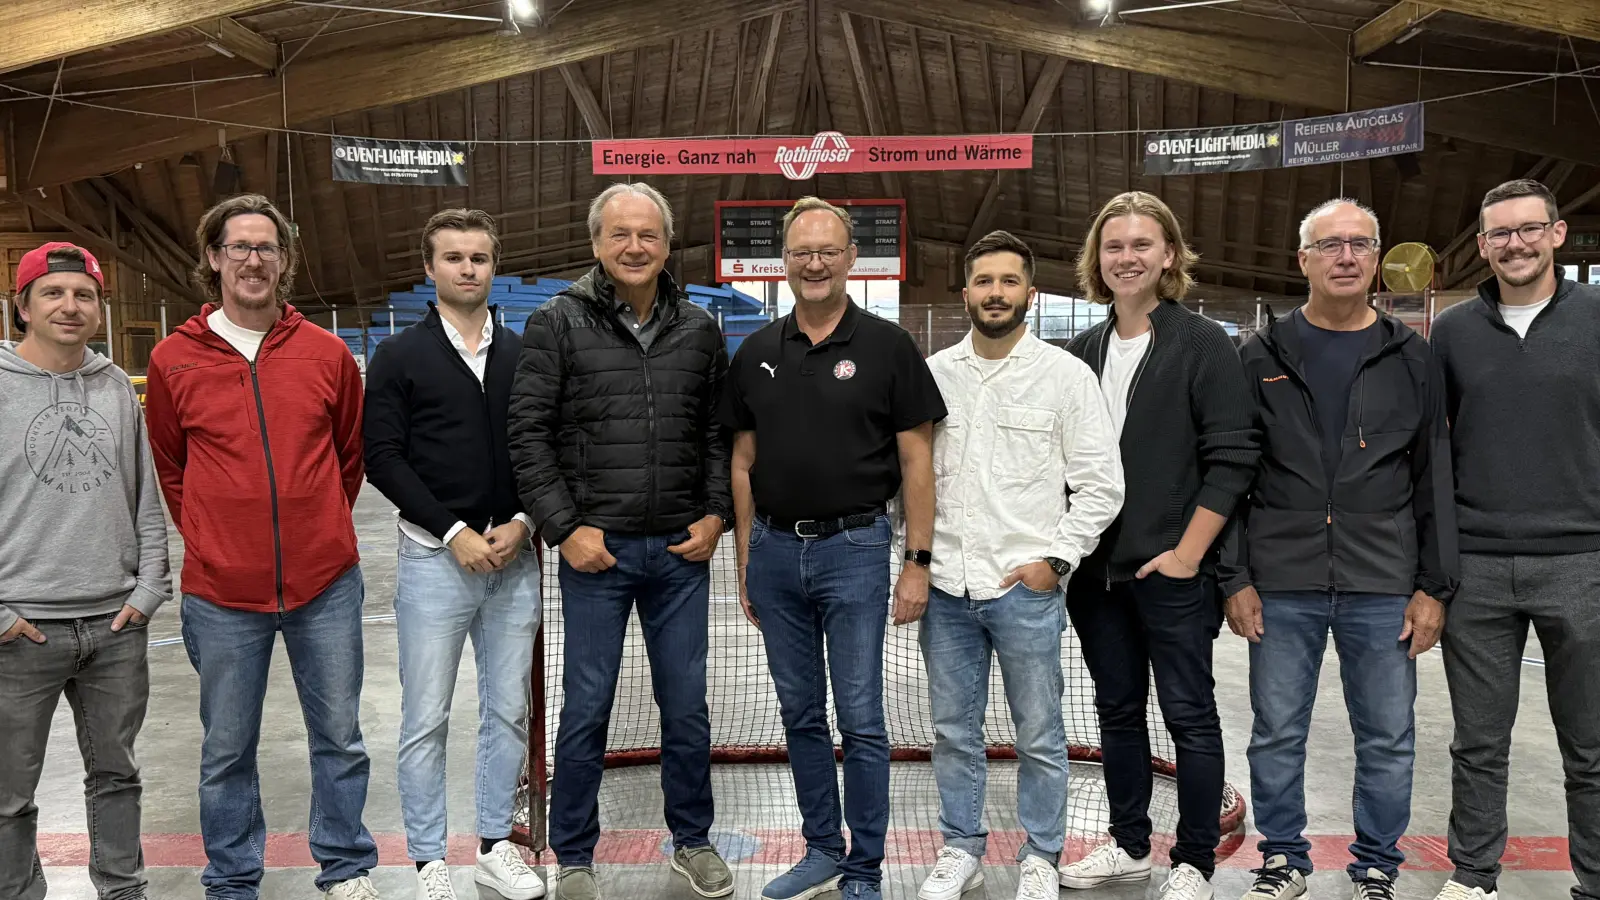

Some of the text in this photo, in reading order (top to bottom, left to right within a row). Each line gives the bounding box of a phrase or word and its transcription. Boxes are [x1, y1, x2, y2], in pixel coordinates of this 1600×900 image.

[1295, 112, 1404, 136] REIFEN & AUTOGLAS
[868, 144, 1022, 162] Strom und Wärme
[1159, 133, 1266, 155] EVENT-LIGHT-MEDIA
[1294, 141, 1339, 155] MÜLLER
[1320, 151, 1359, 162] AUTOGLAS
[1366, 147, 1391, 156] SMART
[1392, 143, 1418, 152] REPAIR
[347, 146, 452, 166] EVENT-LIGHT-MEDIA
[603, 149, 756, 168] Energie. Ganz nah
[774, 146, 854, 163] Rothmoser
[752, 264, 786, 274] Kreiss
[30, 413, 51, 456] MOUNTAIN
[41, 469, 112, 493] MALOJA
